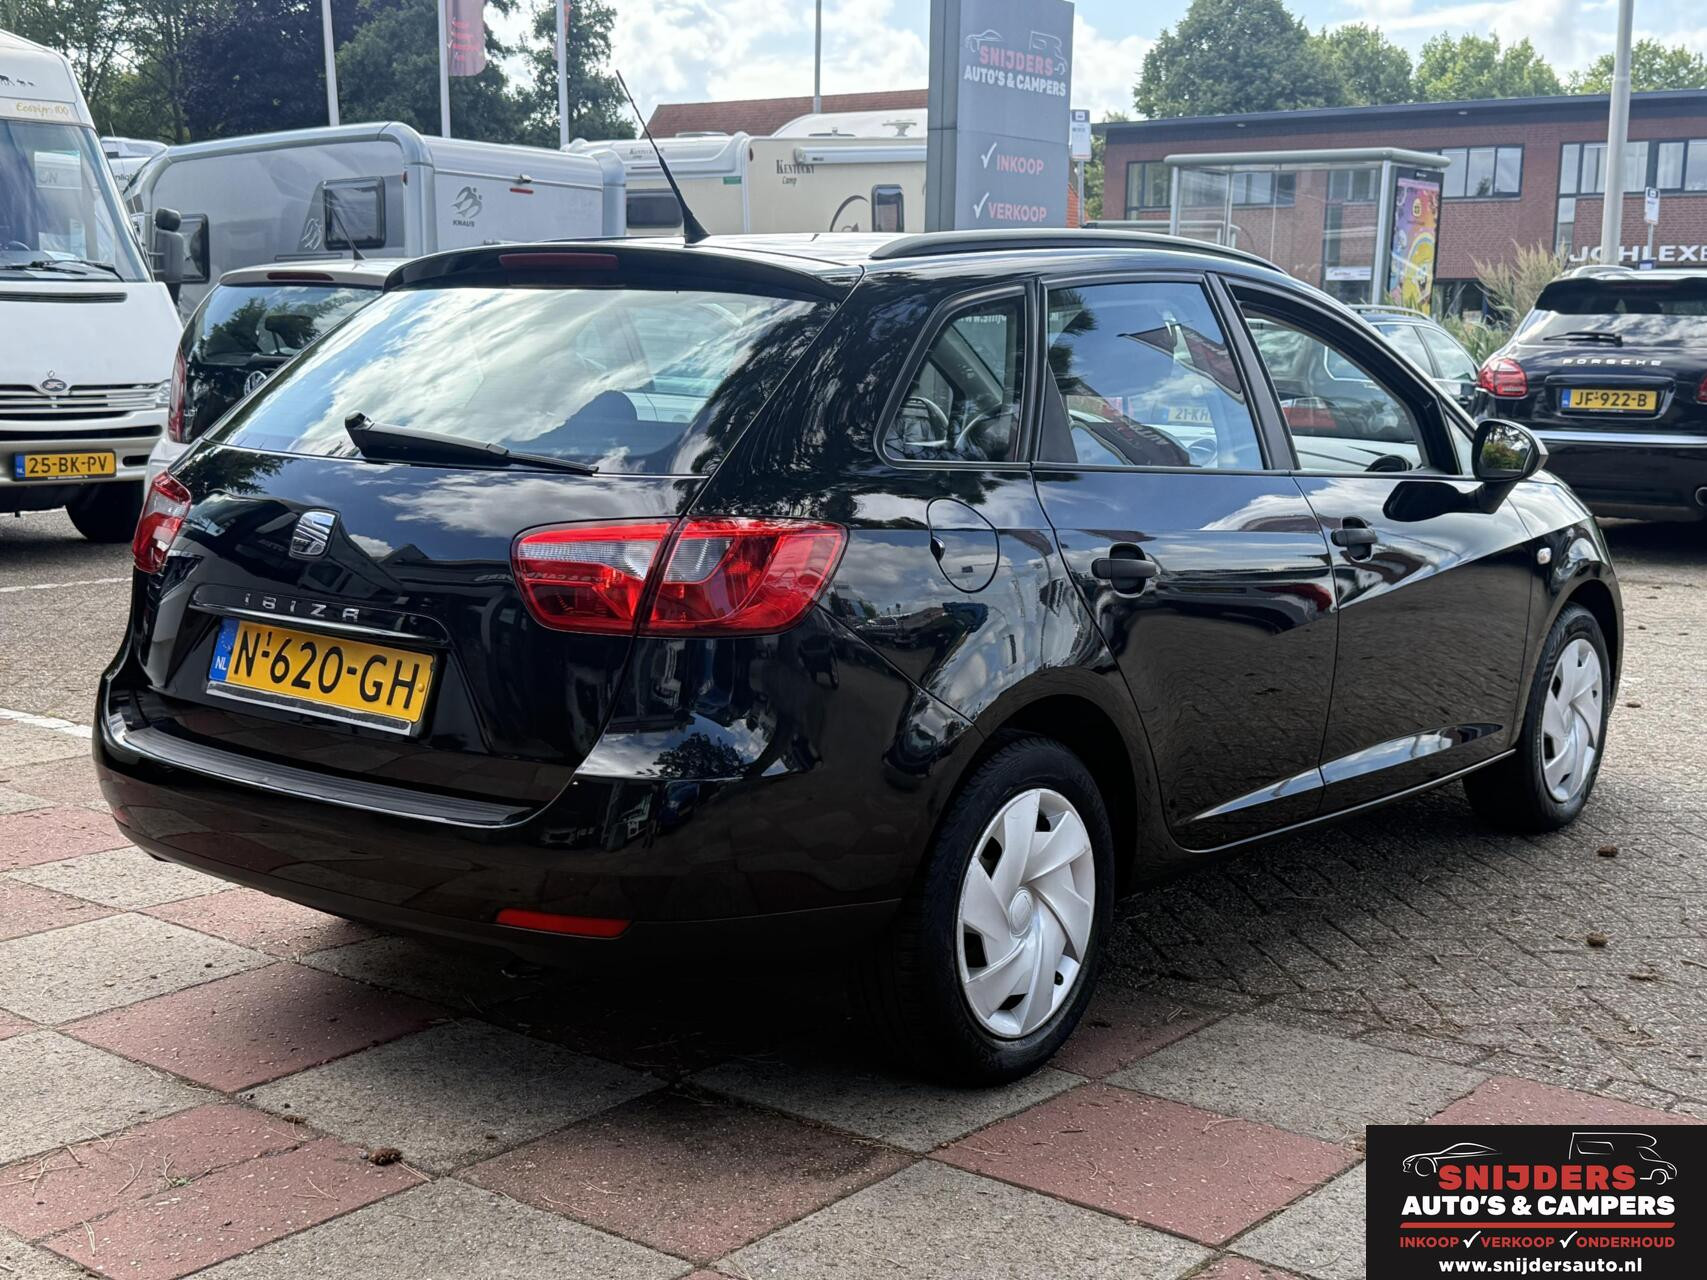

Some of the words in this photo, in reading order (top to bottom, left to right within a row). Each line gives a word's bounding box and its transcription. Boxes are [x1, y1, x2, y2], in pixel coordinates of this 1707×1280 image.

[979, 45, 1054, 76] SNIJDERS
[964, 65, 1006, 87] AUTO'S
[1006, 73, 1015, 88] &
[1016, 75, 1066, 97] CAMPERS
[996, 154, 1045, 175] INKOOP
[988, 202, 1047, 222] VERKOOP
[1562, 358, 1662, 366] PORSCHE
[29, 456, 107, 474] 25-BK-PV
[244, 593, 360, 619] IBIZA
[215, 656, 227, 671] NL
